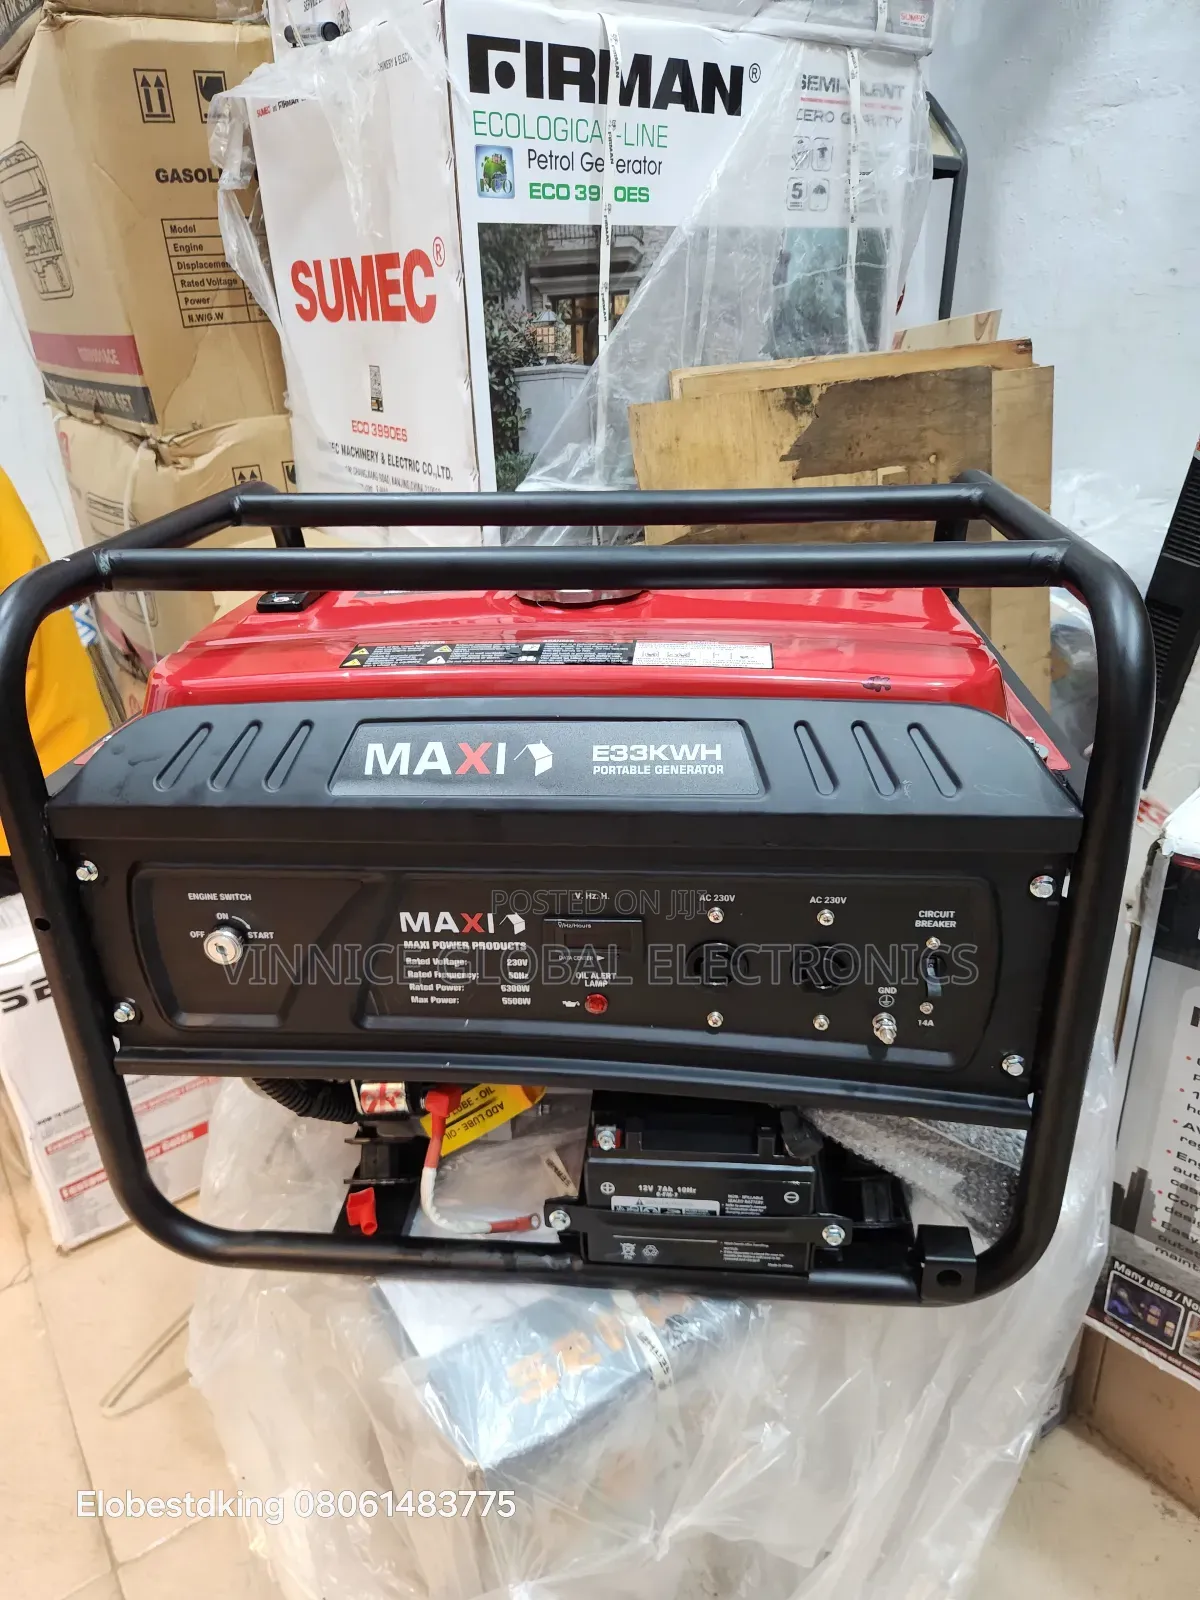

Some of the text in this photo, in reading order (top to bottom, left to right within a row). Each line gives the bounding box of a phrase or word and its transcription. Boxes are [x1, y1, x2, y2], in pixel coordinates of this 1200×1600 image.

[466, 34, 744, 116] FIRMAN
[472, 109, 669, 149] ECOLOGICA-LINE
[528, 149, 662, 176] Petrol Geerator
[529, 183, 571, 200] ECO
[169, 224, 197, 234] Model
[173, 242, 204, 254] Engine
[180, 278, 238, 289] Rated Voltage
[290, 248, 437, 324] SUMEC
[184, 296, 211, 306] Power
[351, 420, 370, 437] ECO
[340, 444, 379, 465] MACHINERY
[381, 452, 386, 465] &
[387, 455, 421, 474] ELECTRIC
[592, 743, 722, 762] E33KWH
[364, 742, 506, 776] MAXI
[593, 764, 724, 776] PORTABLE GENERATOR
[188, 892, 252, 901] ENGINE SWITCH
[699, 894, 736, 903] AC 230V
[809, 896, 847, 905] AC 230V
[216, 912, 229, 920] ON
[918, 910, 956, 919] CIRCUIT
[399, 912, 495, 934] MAXI
[914, 919, 957, 929] BREAKER
[190, 930, 205, 939] OFF
[247, 931, 274, 940] START
[403, 940, 527, 951] MAXI POWER PRODUCTS
[405, 957, 528, 967] Rated Voltage: 230V
[407, 970, 433, 979] Rated
[508, 971, 529, 980] 50Hz
[590, 972, 617, 980] ALERT
[408, 983, 434, 992] Rated
[435, 983, 465, 992] Power:
[584, 979, 608, 988] LAMP
[877, 986, 898, 996] GND
[410, 995, 429, 1004] Max
[430, 996, 460, 1005] Power:
[917, 1019, 934, 1028] 14A
[478, 1085, 496, 1099] OIL
[485, 1101, 505, 1118] ADD
[463, 1112, 486, 1131] LUBE
[657, 1185, 673, 1193] 7Ah
[1113, 1260, 1146, 1284] Many
[1146, 1279, 1174, 1299] uses
